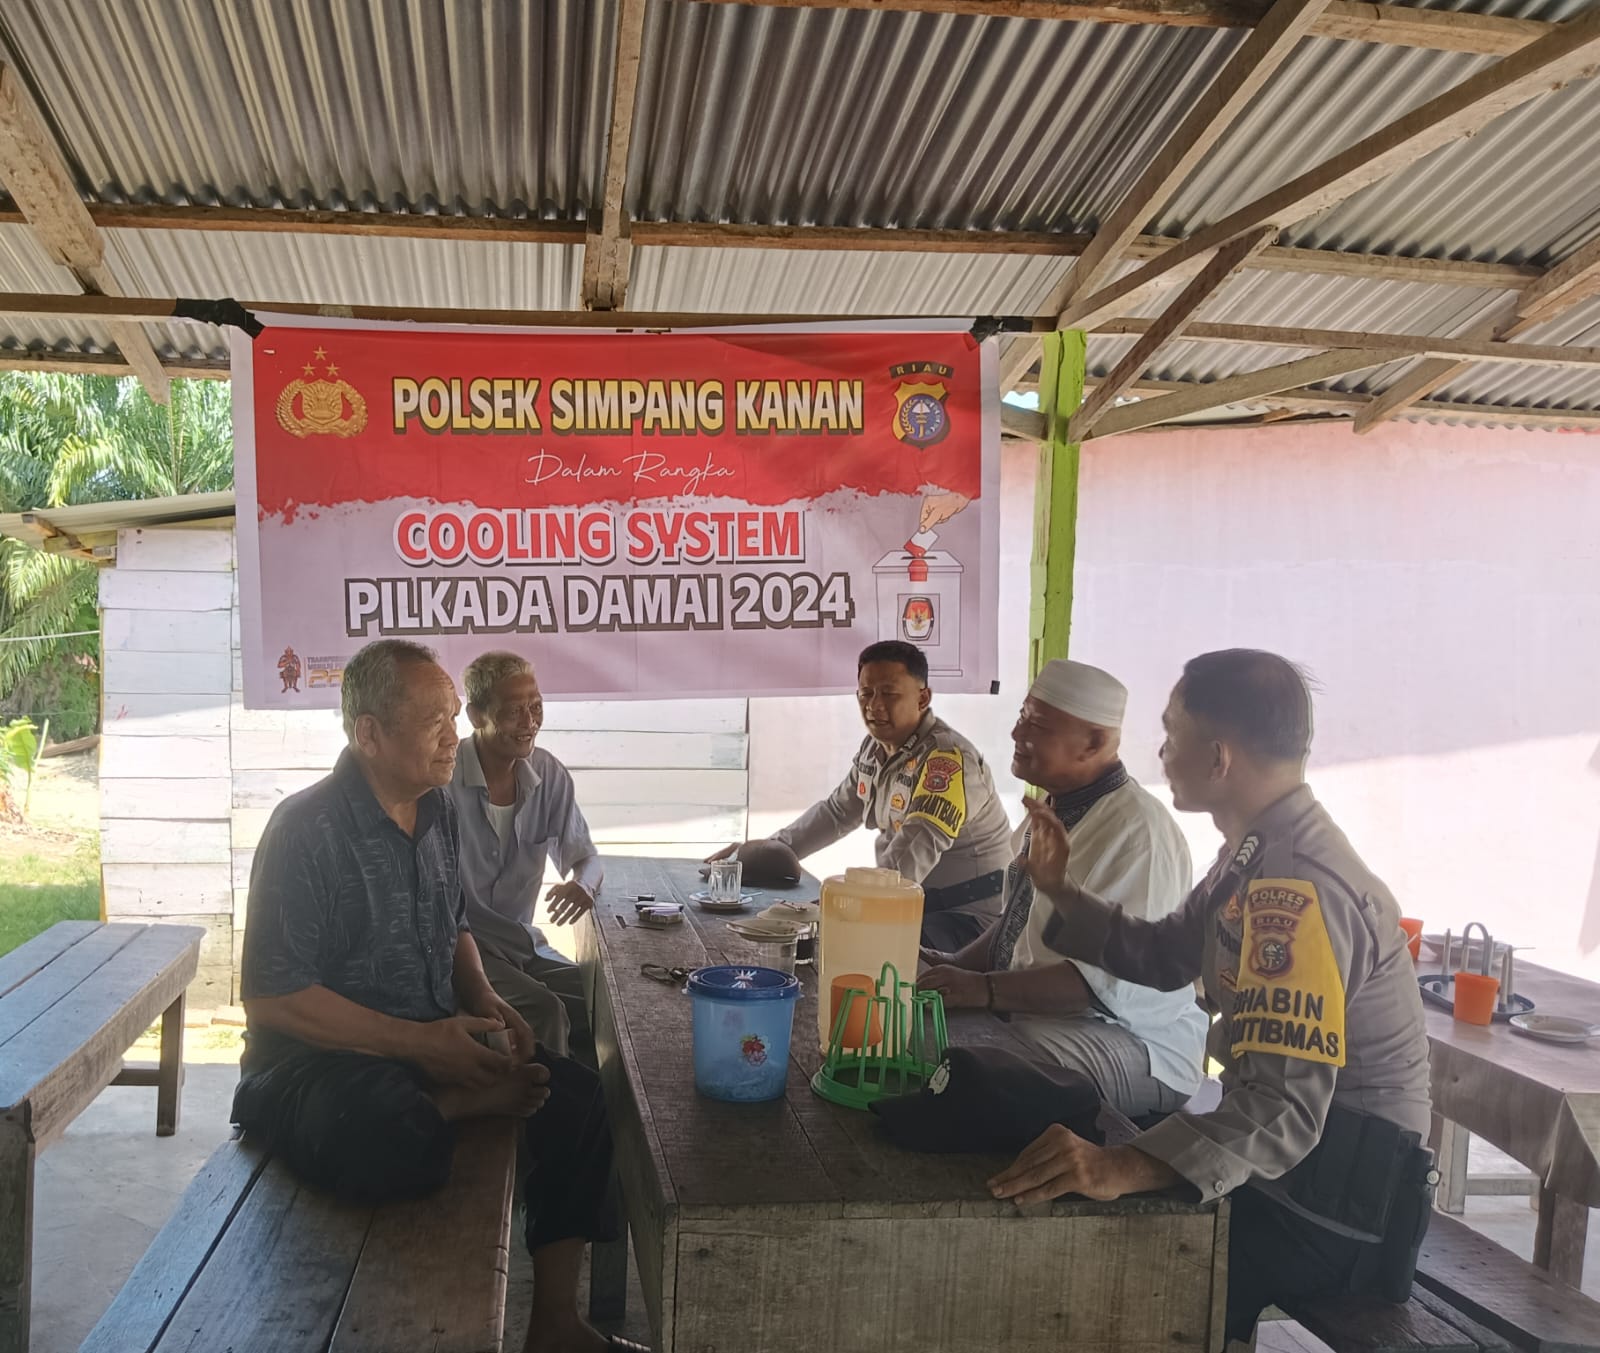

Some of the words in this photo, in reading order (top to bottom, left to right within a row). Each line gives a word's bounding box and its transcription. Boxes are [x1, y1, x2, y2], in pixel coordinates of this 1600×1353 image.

[896, 363, 947, 375] RIAU
[392, 376, 542, 435] POLSEK
[549, 377, 725, 436] SIMPANG
[734, 379, 865, 436] KANAN
[525, 448, 622, 486] Dalam
[622, 450, 736, 496] Rangka
[393, 508, 616, 567] COOLING
[624, 509, 807, 565] SYSTEM
[344, 576, 559, 637] PILKADA
[565, 575, 723, 634] DAMAI
[731, 572, 855, 630] 2024
[1251, 890, 1305, 905] POLRES
[1256, 917, 1294, 927] RIAU
